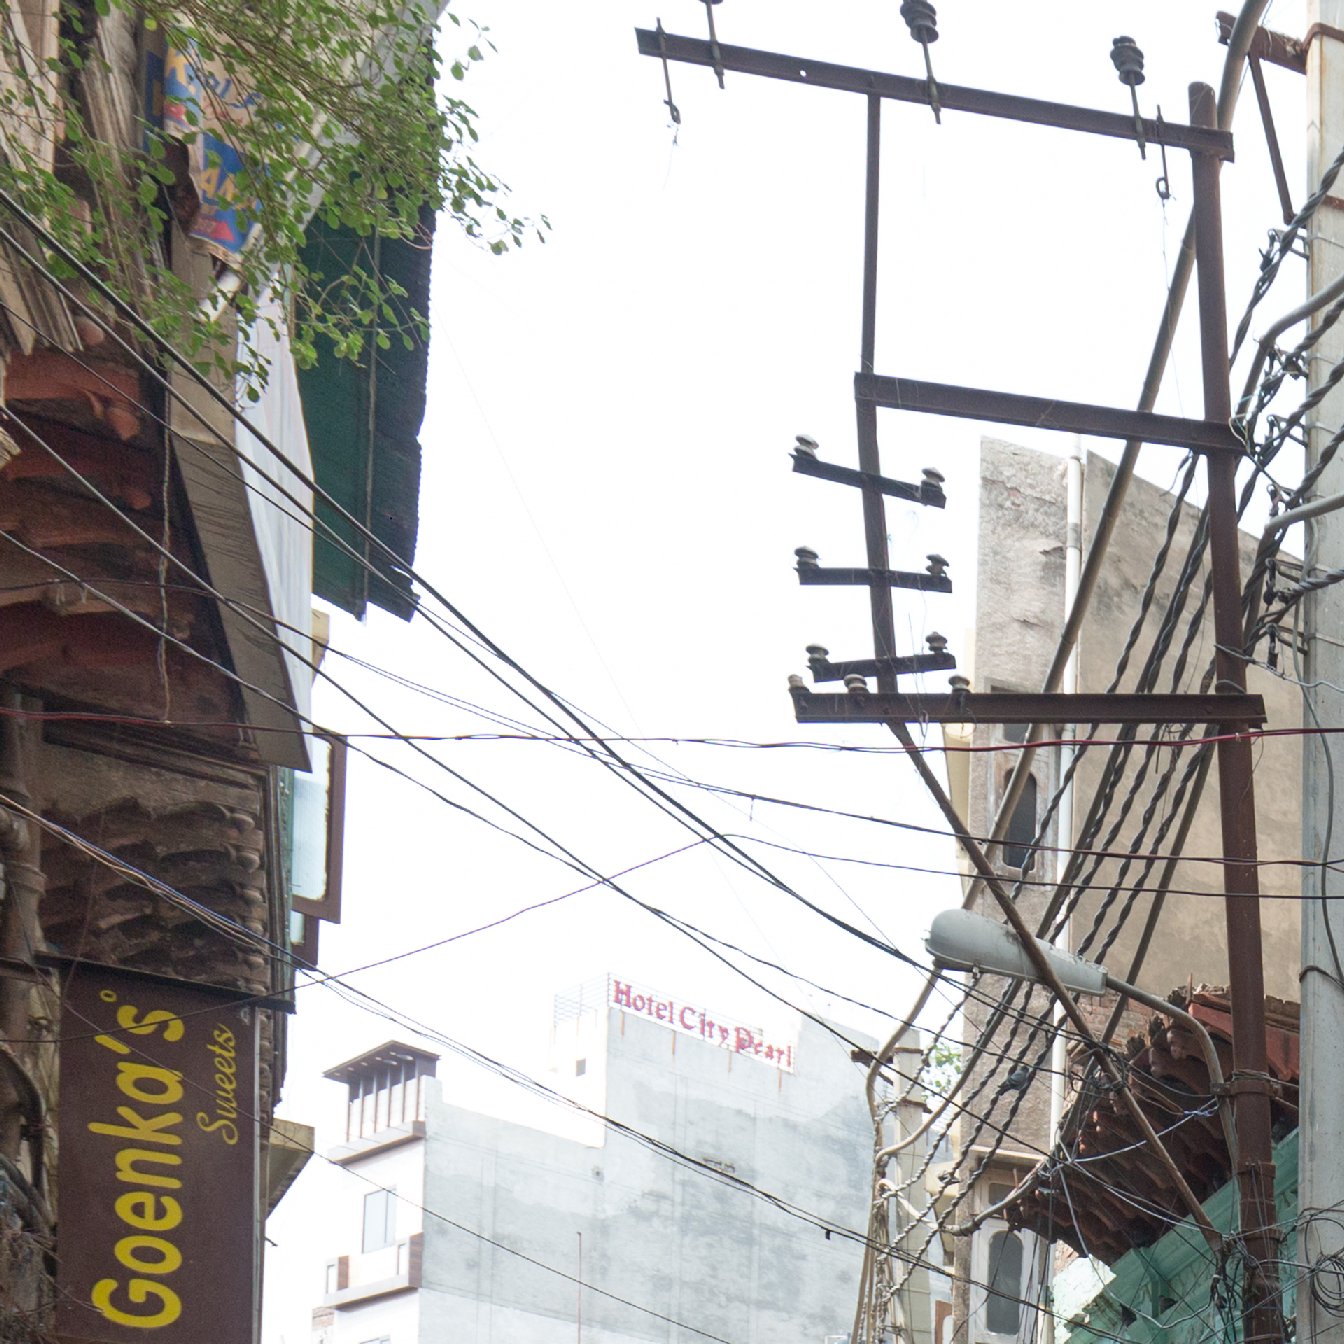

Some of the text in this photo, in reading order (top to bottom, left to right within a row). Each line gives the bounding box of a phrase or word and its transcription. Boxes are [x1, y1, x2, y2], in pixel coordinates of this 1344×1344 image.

[613, 979, 792, 1068] Hotel City Pearl
[197, 1024, 240, 1146] Sweets
[87, 1004, 185, 1329] Goenka's
